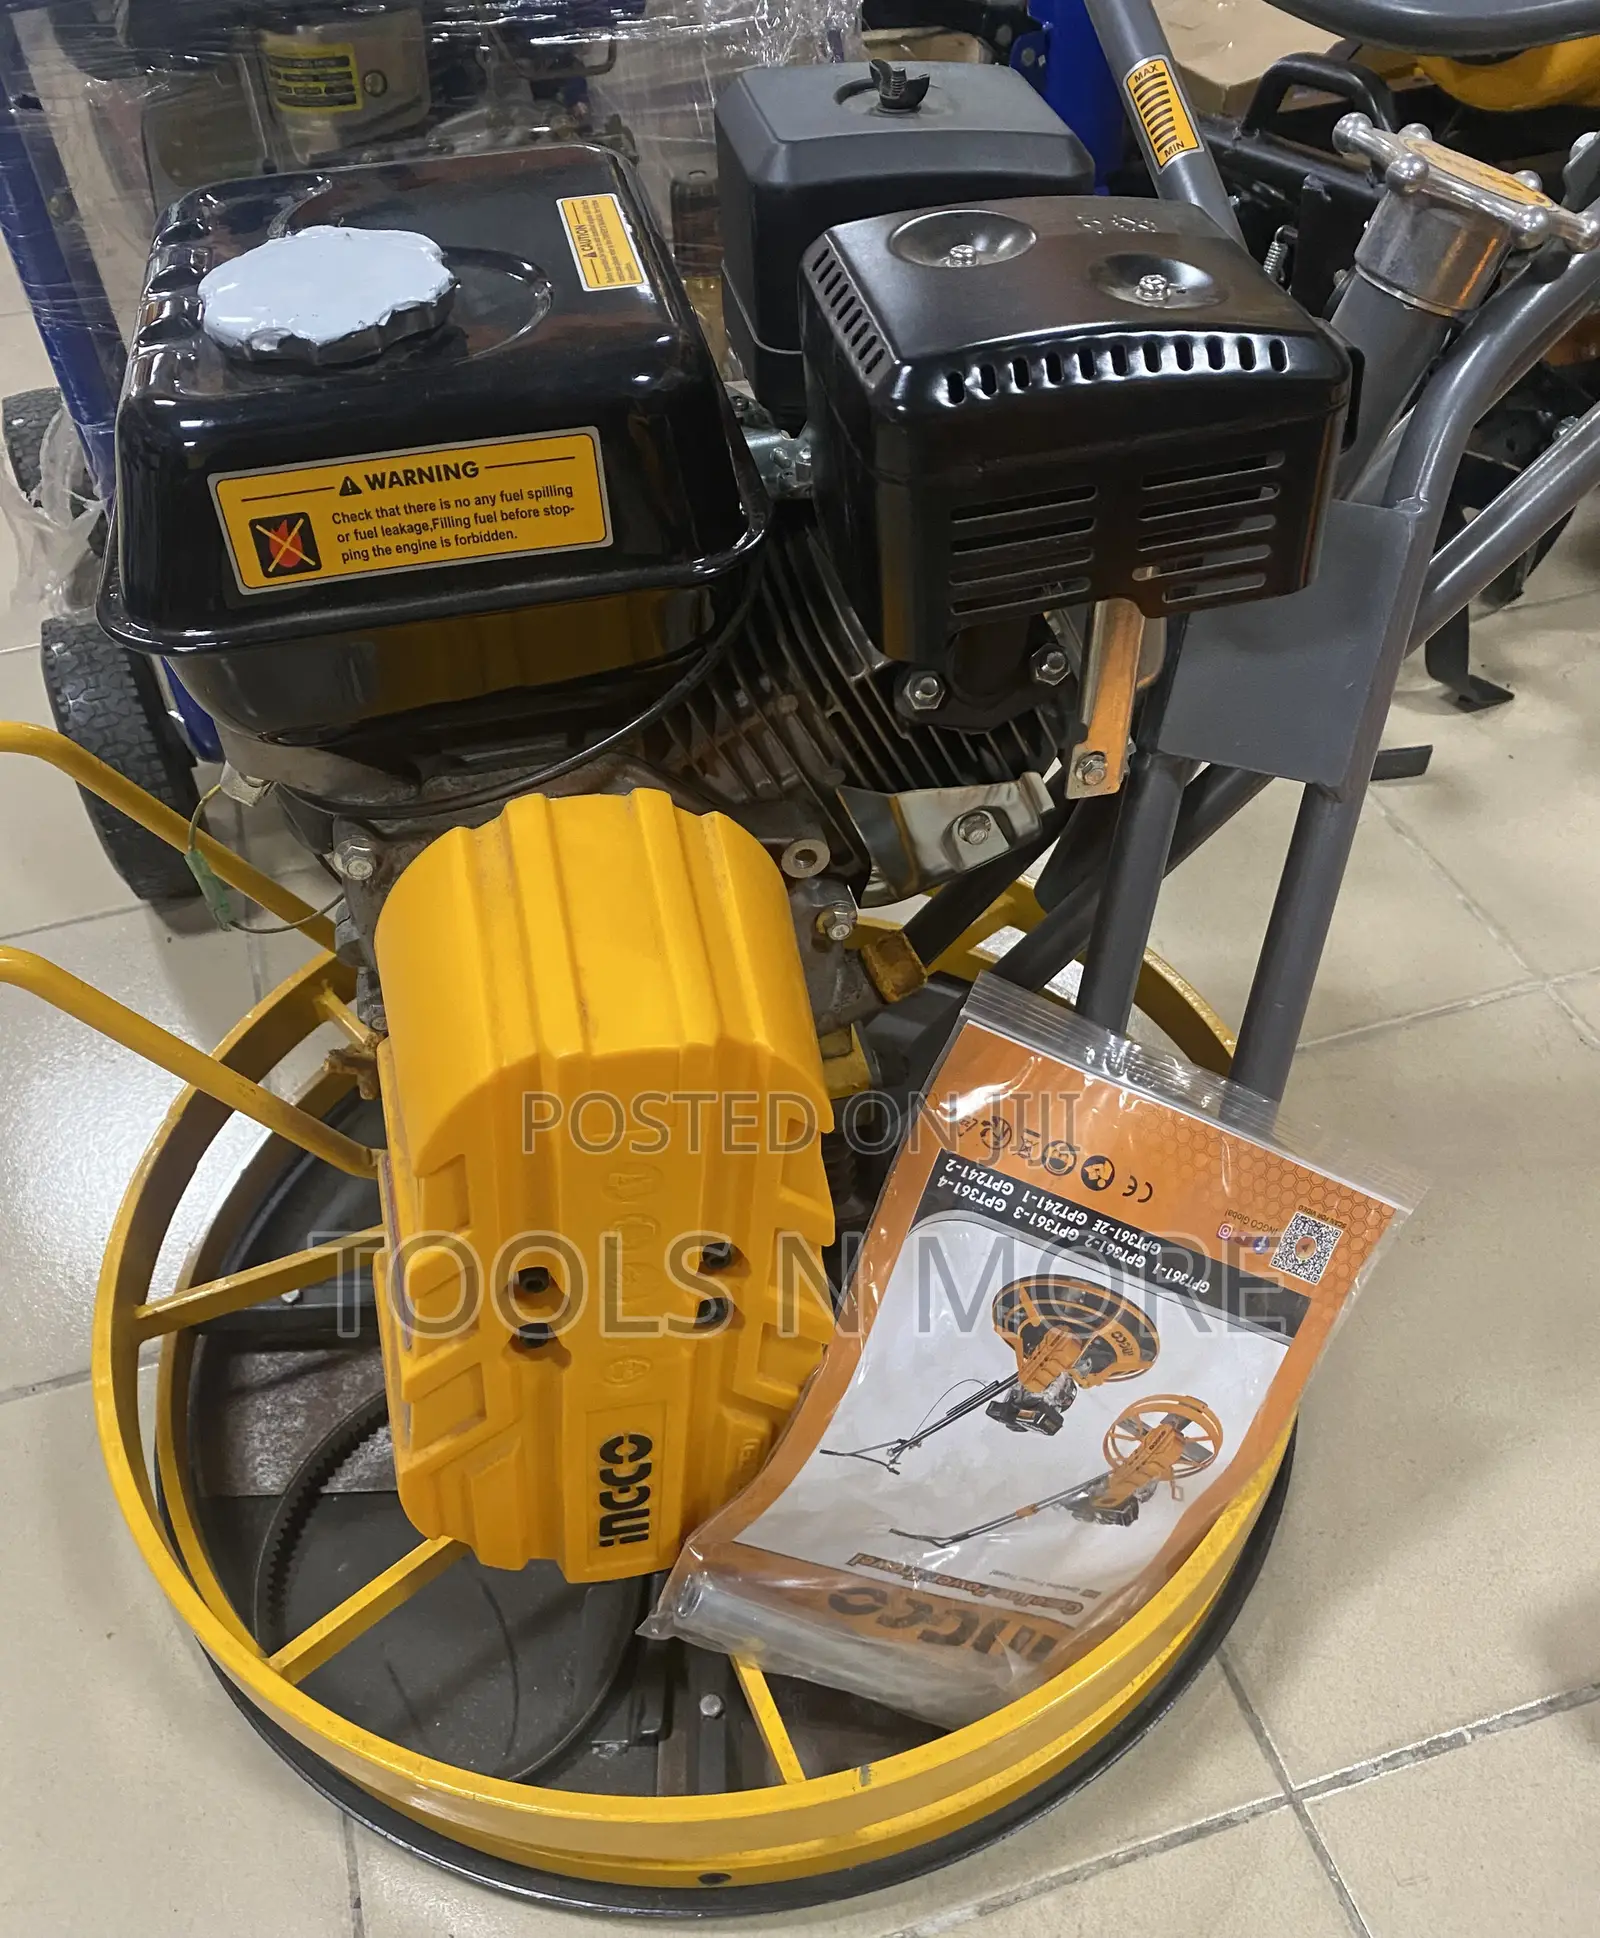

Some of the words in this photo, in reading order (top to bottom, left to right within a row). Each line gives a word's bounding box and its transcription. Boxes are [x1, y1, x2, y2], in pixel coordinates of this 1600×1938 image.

[1134, 64, 1159, 83] MAX
[1164, 140, 1185, 158] MIN
[575, 224, 594, 252] CAUTION
[364, 461, 479, 491] WARNING
[332, 508, 373, 525] Check
[376, 504, 401, 519] that
[403, 502, 436, 515] there
[439, 498, 451, 510] is
[454, 497, 471, 508] no
[474, 494, 496, 507] any
[499, 488, 524, 503] fuel
[527, 484, 573, 501] spilling
[337, 532, 351, 543] or
[353, 526, 379, 541] fuel
[473, 511, 498, 525] fuel
[500, 508, 540, 522] before
[543, 504, 575, 517] stop-
[341, 548, 370, 565] ping
[372, 544, 392, 558] the
[395, 538, 437, 555] engine
[440, 536, 451, 548] is
[454, 529, 518, 546] forbidden.
[937, 1175, 1007, 1212] GPT361-4
[945, 1159, 1014, 1196] GPT241-2
[1013, 1206, 1080, 1241] GPT361-3
[1022, 1190, 1088, 1225] GPT241-1
[1224, 1208, 1251, 1225] Global
[1084, 1234, 1147, 1268] GPT361-2
[1092, 1219, 1161, 1255] GPT361-2E
[1152, 1262, 1210, 1293] GPT361-1
